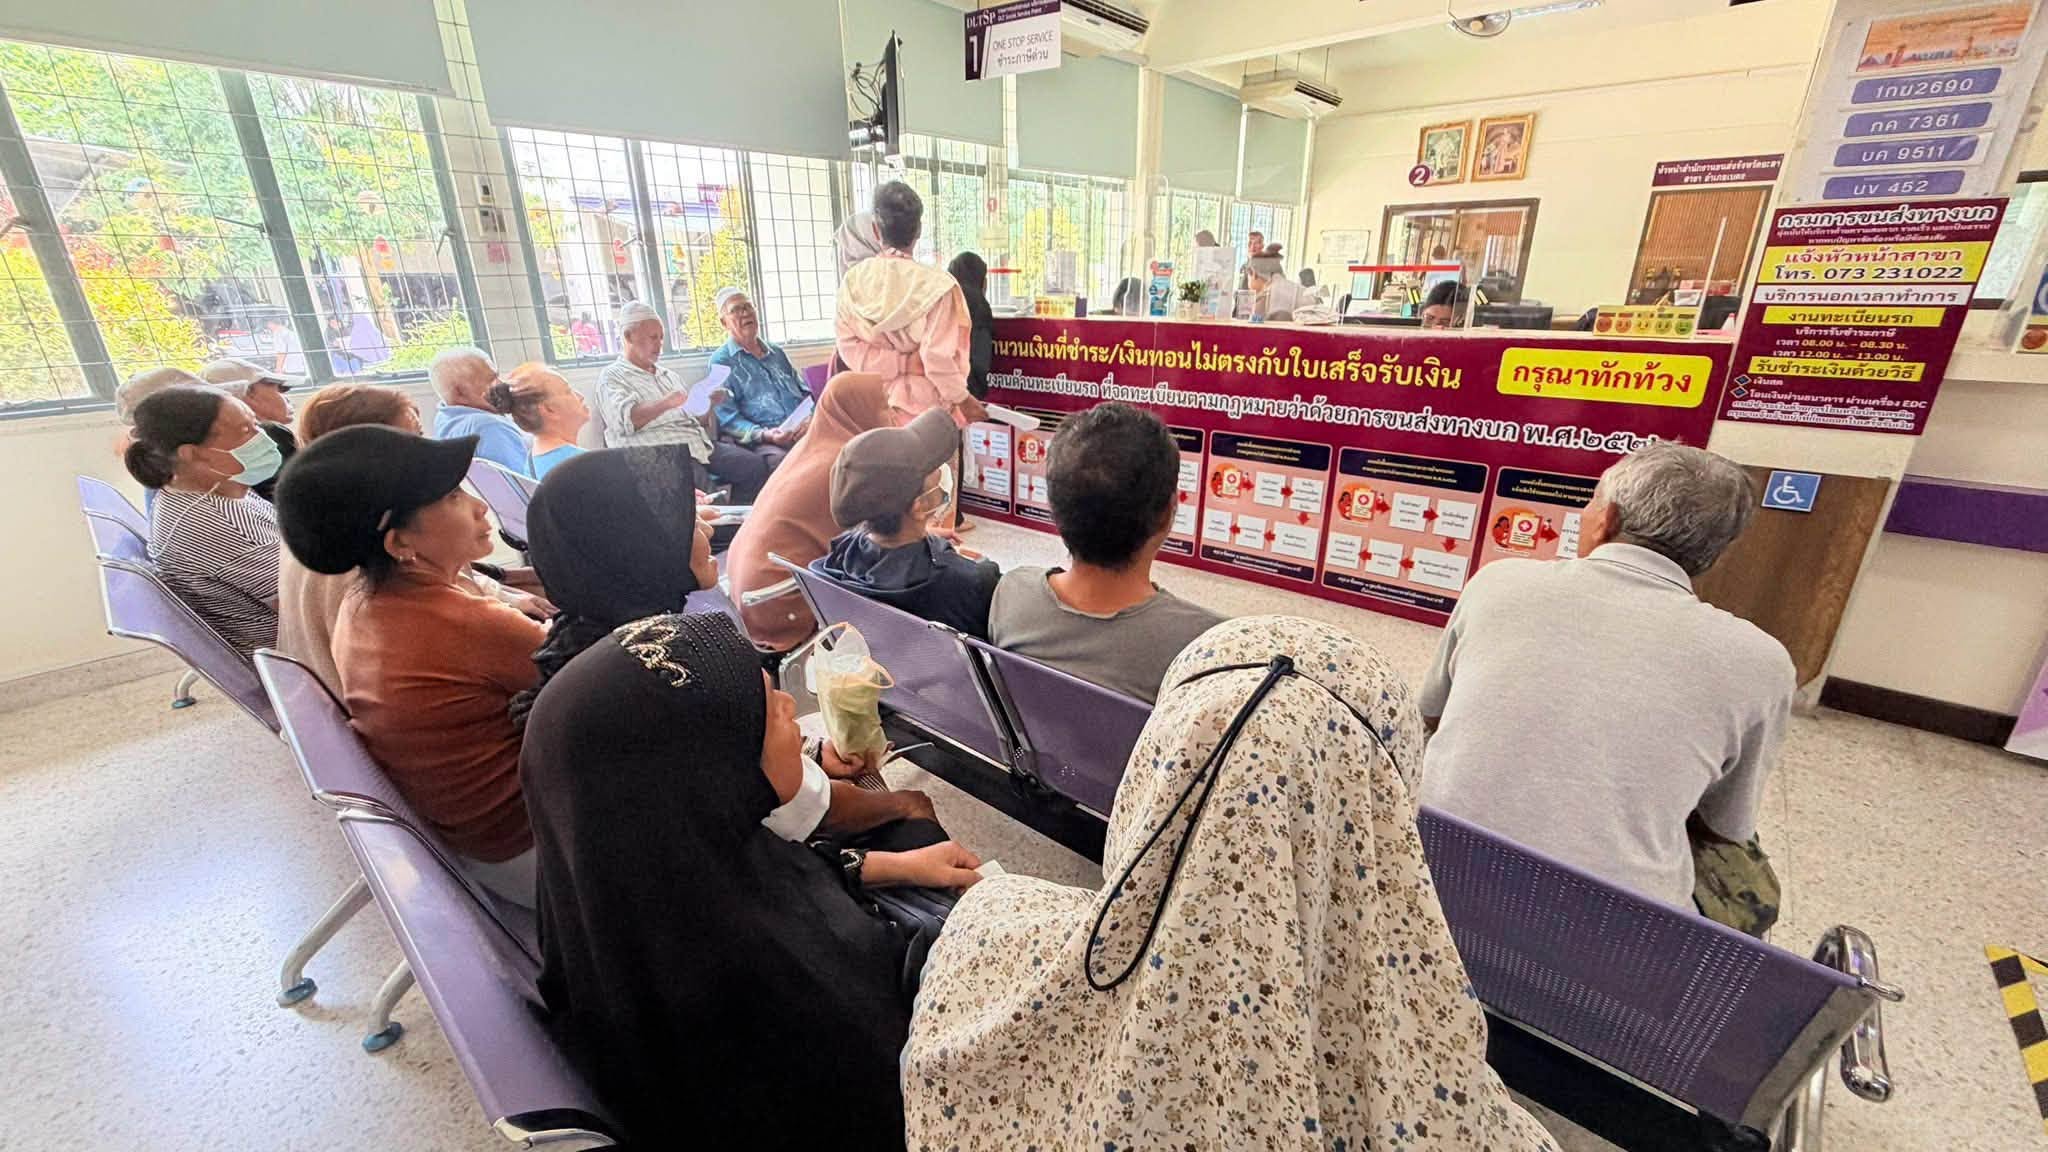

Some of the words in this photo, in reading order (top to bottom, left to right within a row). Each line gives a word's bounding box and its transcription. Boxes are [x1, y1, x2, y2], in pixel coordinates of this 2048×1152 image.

[993, 39, 1007, 50] ONE
[1007, 36, 1026, 48] STOP
[1027, 30, 1054, 46] SERVICE
[969, 35, 978, 73] 1
[1909, 113, 1960, 129] 7361
[1897, 145, 1945, 160] 9511
[1413, 167, 1425, 184] 2
[1888, 180, 1928, 193] 452
[1777, 204, 1995, 227] กรมการขนส่งทางบก
[1785, 246, 1962, 264] แจ้งหัวหน้าสาขา
[1776, 265, 1816, 280] โทร.
[1824, 268, 1866, 280] 073
[1872, 267, 1963, 279] 231022
[1764, 286, 1958, 302] บริการนอกเวลาทำการ
[1789, 309, 1913, 324] งานทะเบียนรถ
[1796, 327, 1897, 337] บริการรับชำระภาษี
[1801, 339, 1834, 347] 08.00
[1860, 341, 1894, 349] 08.30
[1896, 342, 1909, 350] น.
[990, 329, 1462, 390] ำนวนเงินที่ชำระ/เงินทอนไม่ตรงกับใบเสร็จรับเงิน
[1513, 358, 1693, 394] กรุณาทักท้วง
[1799, 350, 1830, 358] 12.00
[1857, 352, 1890, 360] 13.00
[1757, 359, 1916, 379] รับชำระเงินด้วยวิธี
[1902, 400, 1928, 409] EDC
[1101, 372, 1518, 442] ที่จดทะเบียนตามกฎหมายว่าด้วยการขนส่งทางบก
[1524, 423, 1657, 455] พ.ศ.๒๕๒
